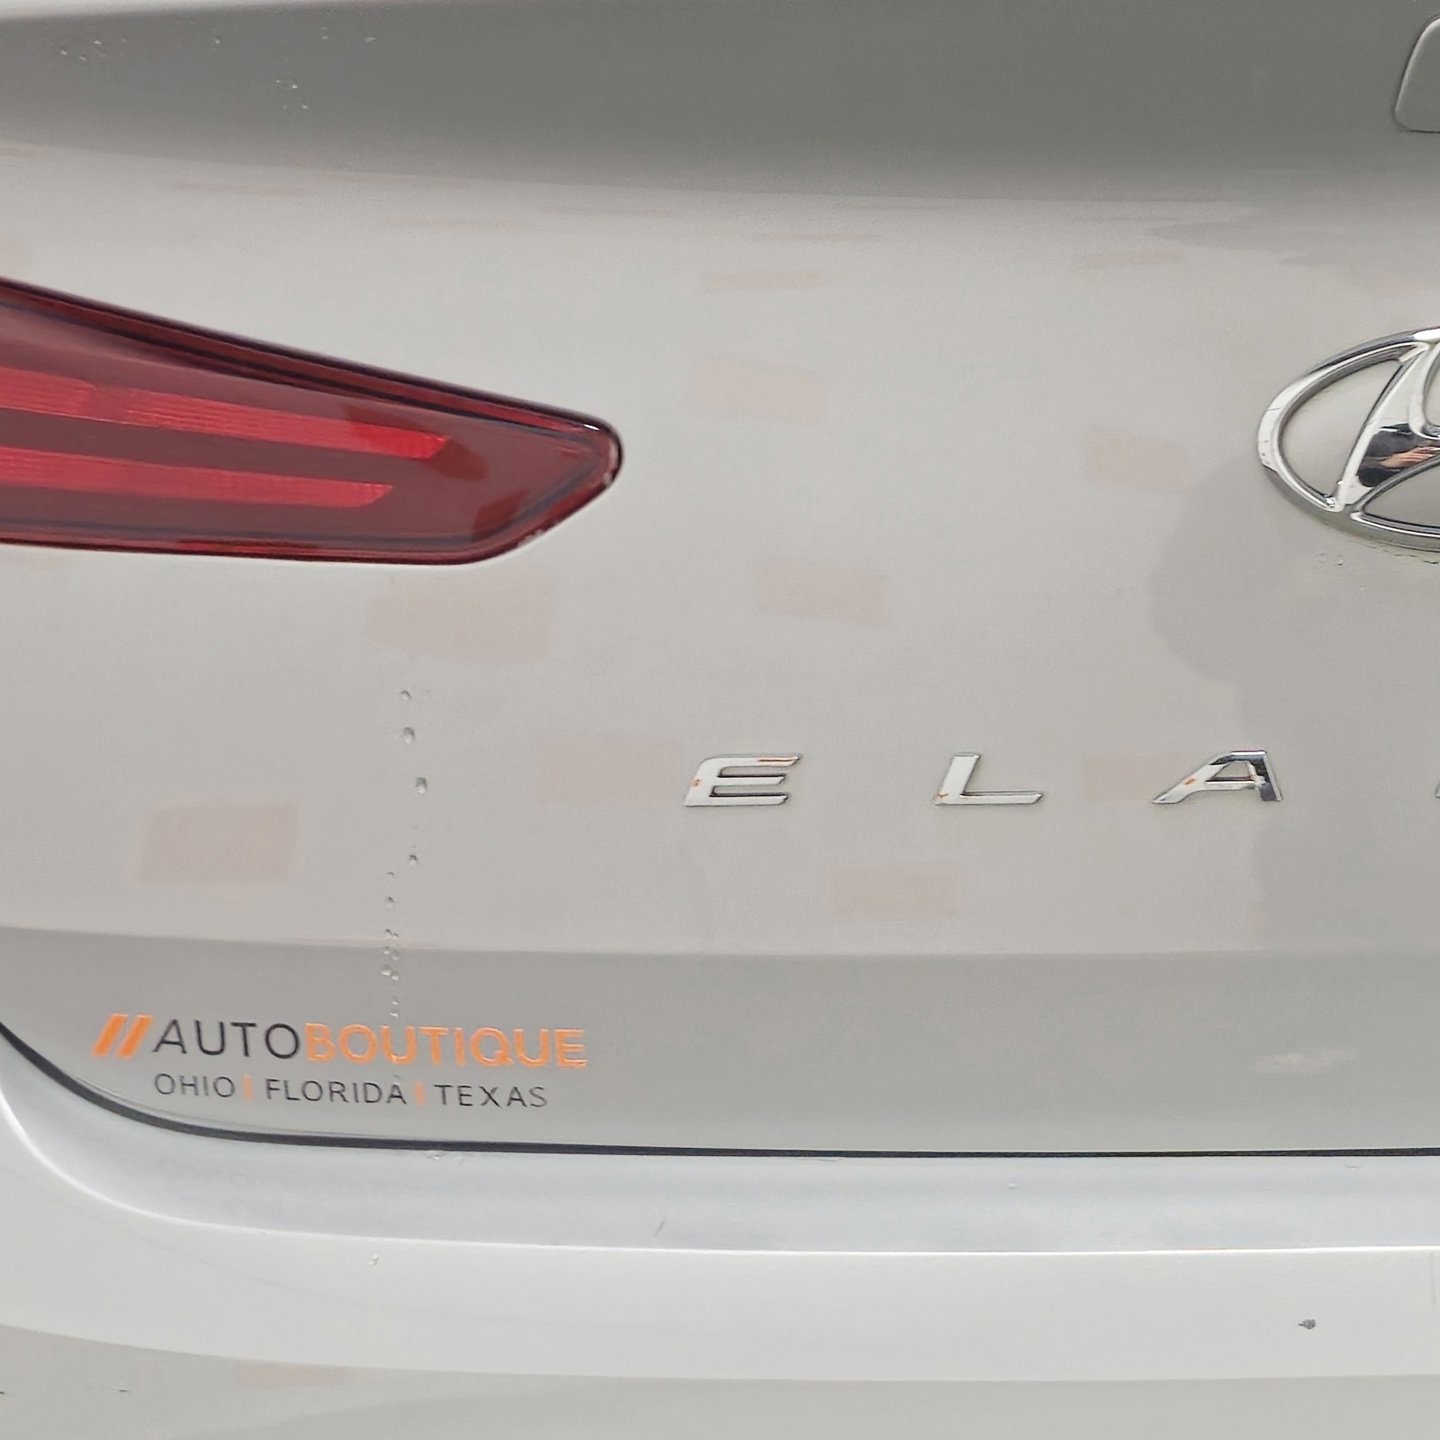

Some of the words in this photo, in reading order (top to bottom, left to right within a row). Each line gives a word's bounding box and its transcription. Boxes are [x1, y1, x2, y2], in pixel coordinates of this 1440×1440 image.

[153, 1071, 237, 1099] OHIO
[264, 1077, 408, 1106] FLORIDA
[432, 1083, 548, 1109] TEXAS
